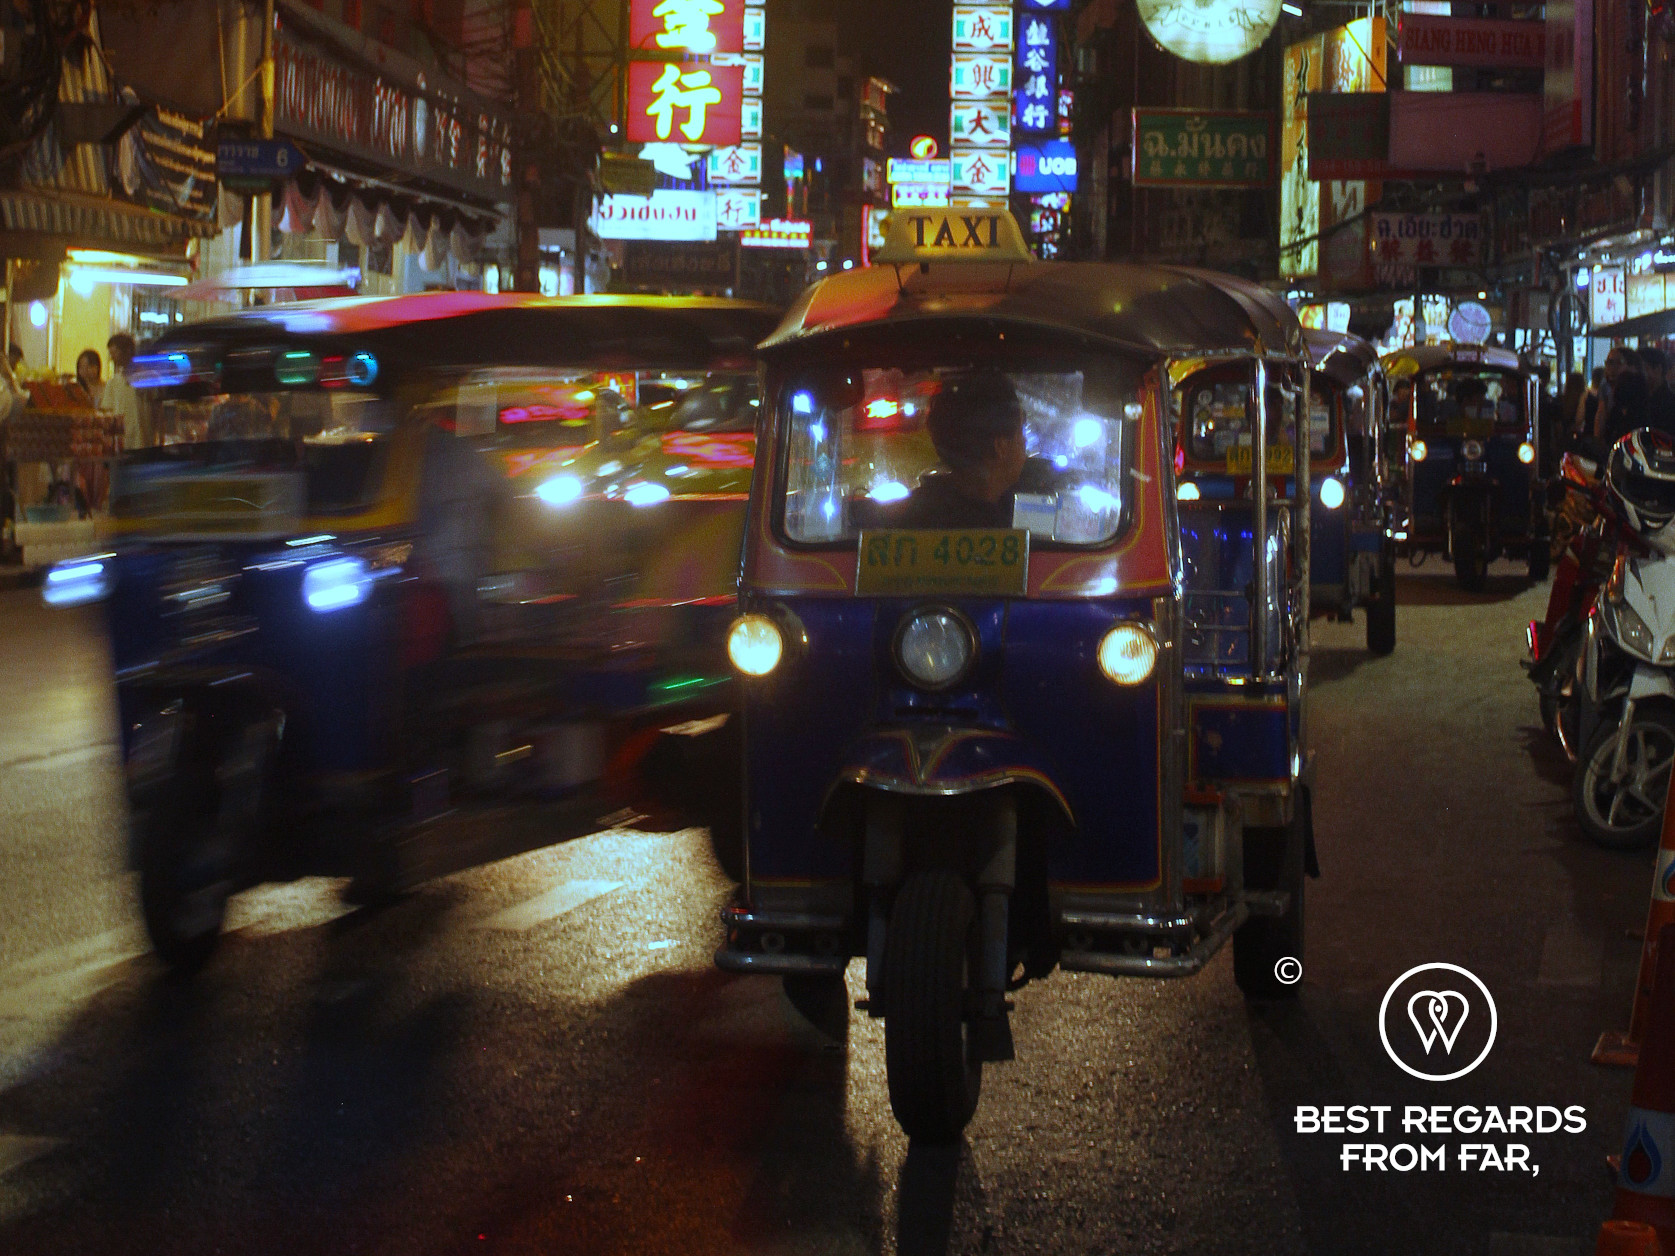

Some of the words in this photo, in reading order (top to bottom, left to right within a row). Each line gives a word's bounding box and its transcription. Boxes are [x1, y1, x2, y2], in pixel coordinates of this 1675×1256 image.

[1038, 157, 1077, 175] UOB
[907, 215, 1000, 249] TAXI
[933, 535, 1020, 566] 4028
